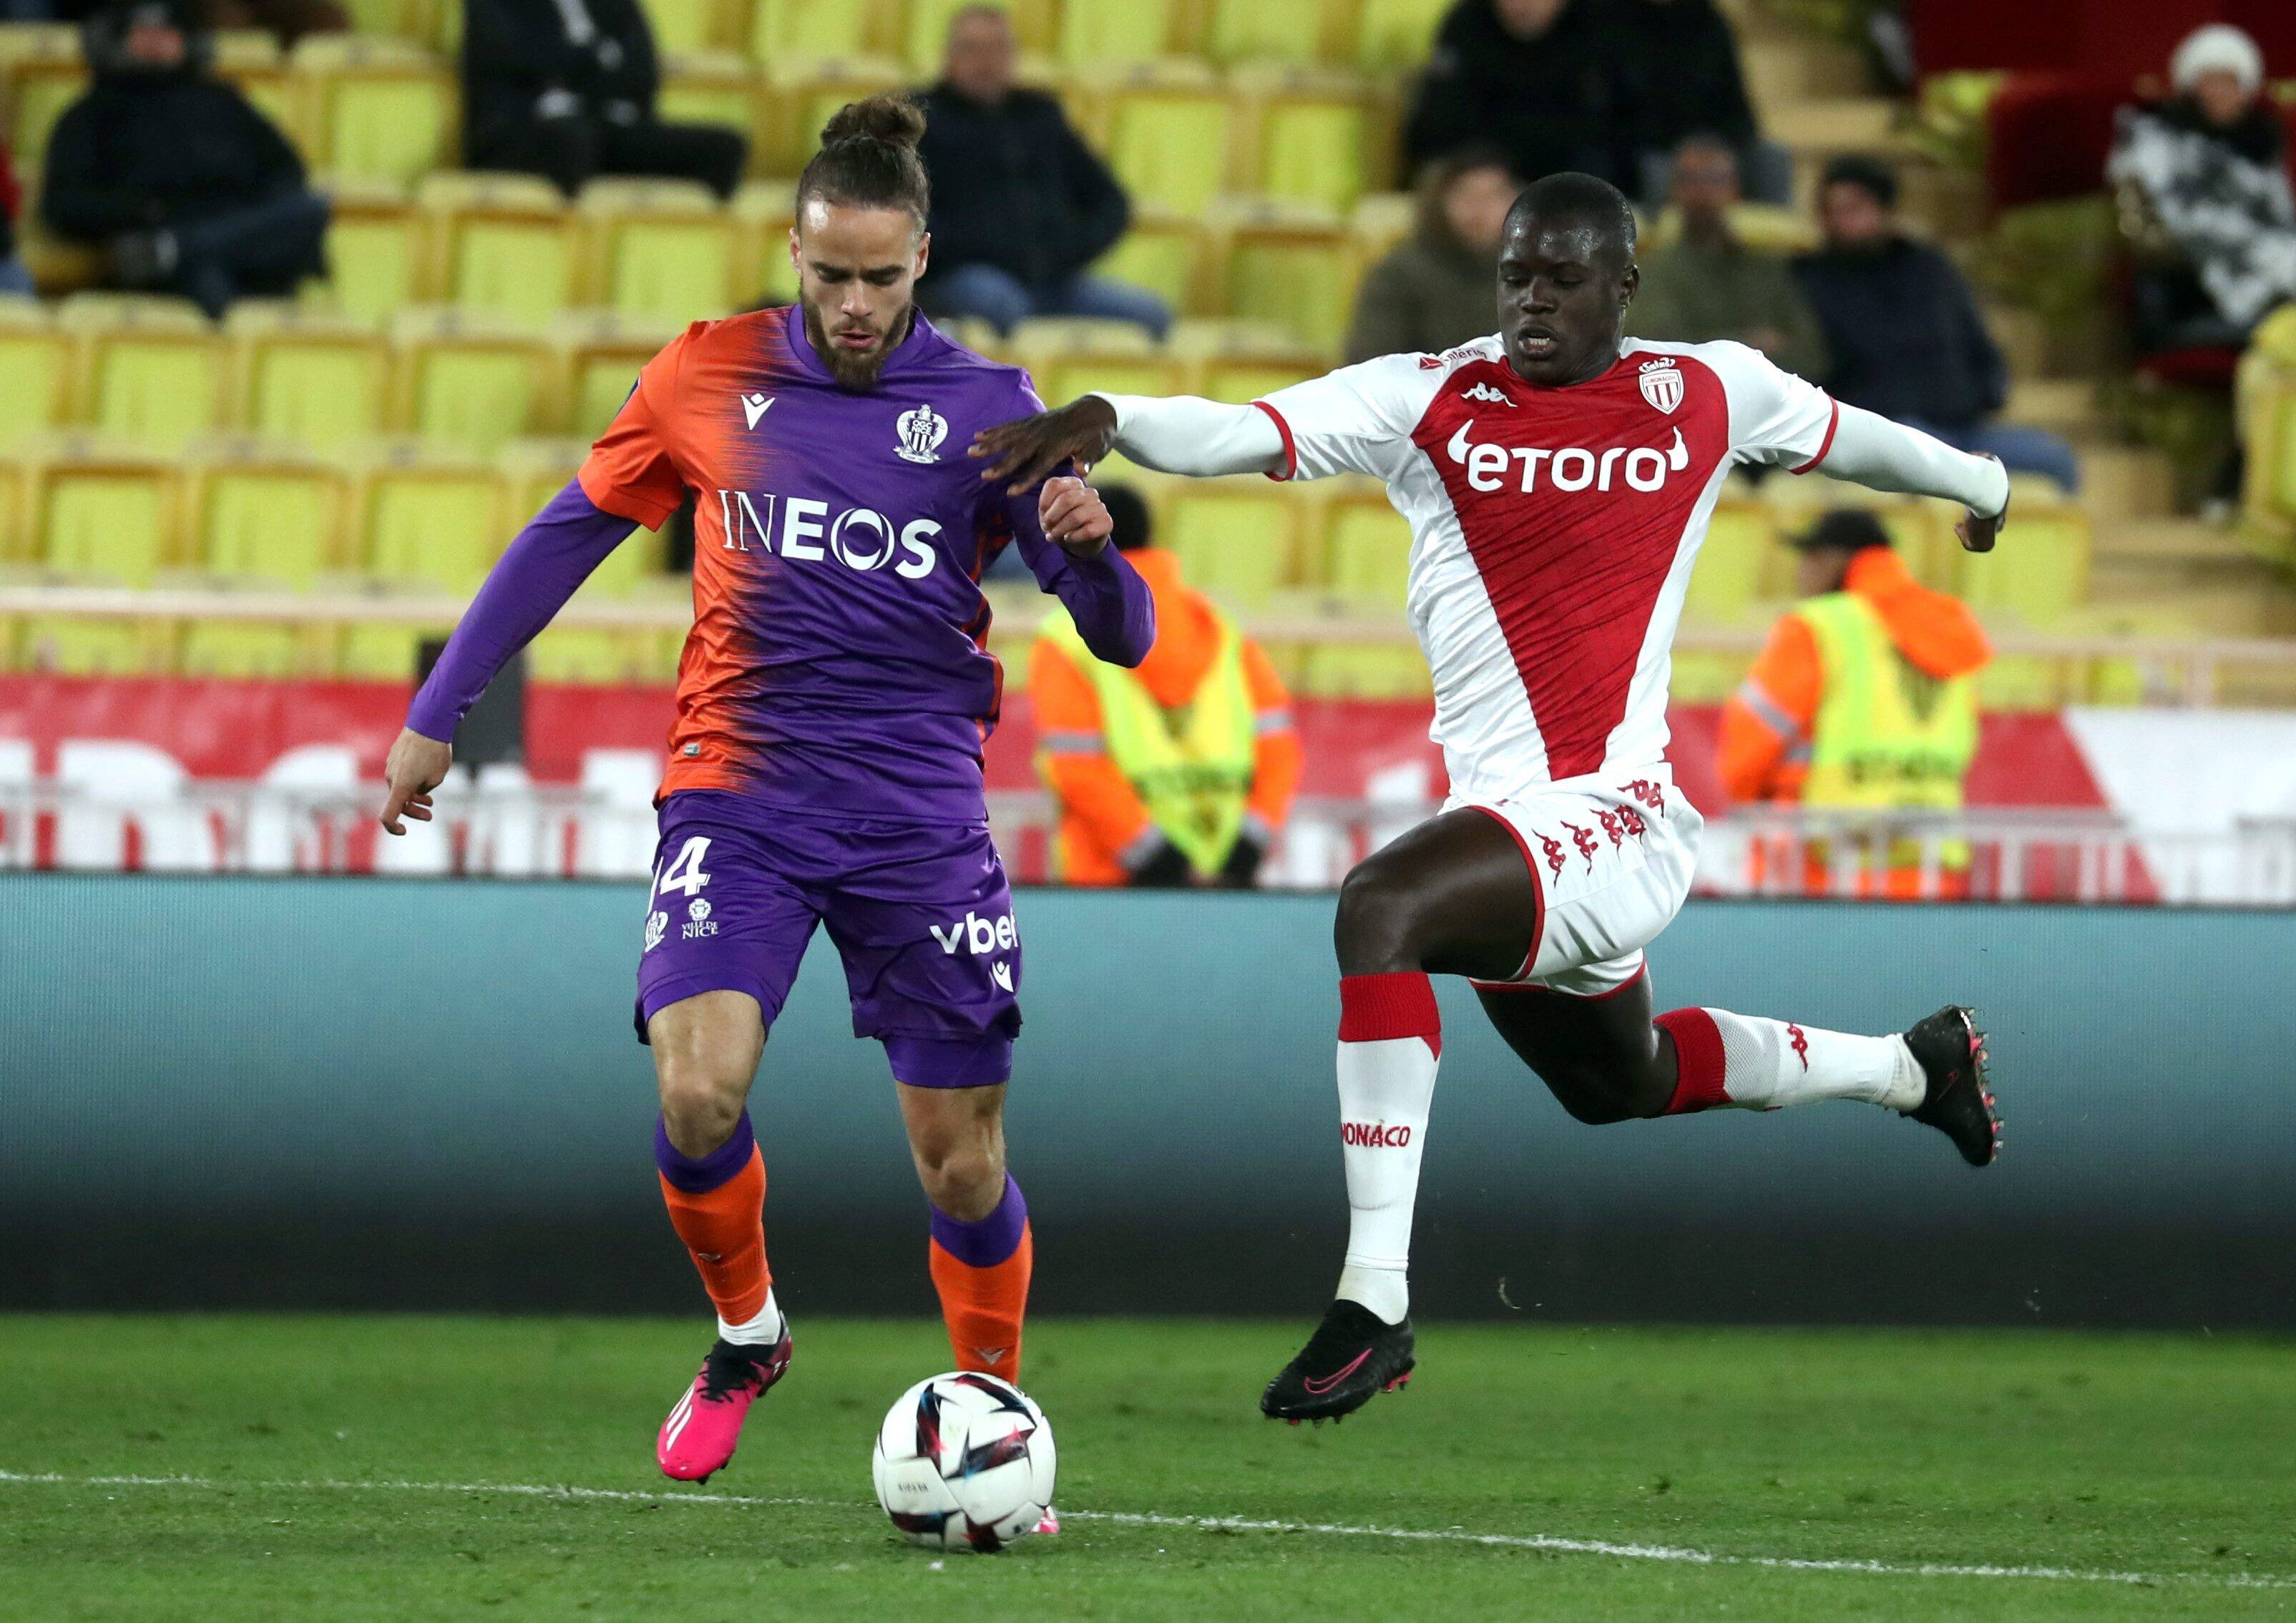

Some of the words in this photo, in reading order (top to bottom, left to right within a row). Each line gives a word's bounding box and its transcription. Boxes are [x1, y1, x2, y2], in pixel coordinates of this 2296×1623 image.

[912, 419, 933, 429] OGC
[911, 426, 932, 436] NICE
[718, 489, 942, 579] INEOS
[681, 927, 719, 940] NICE
